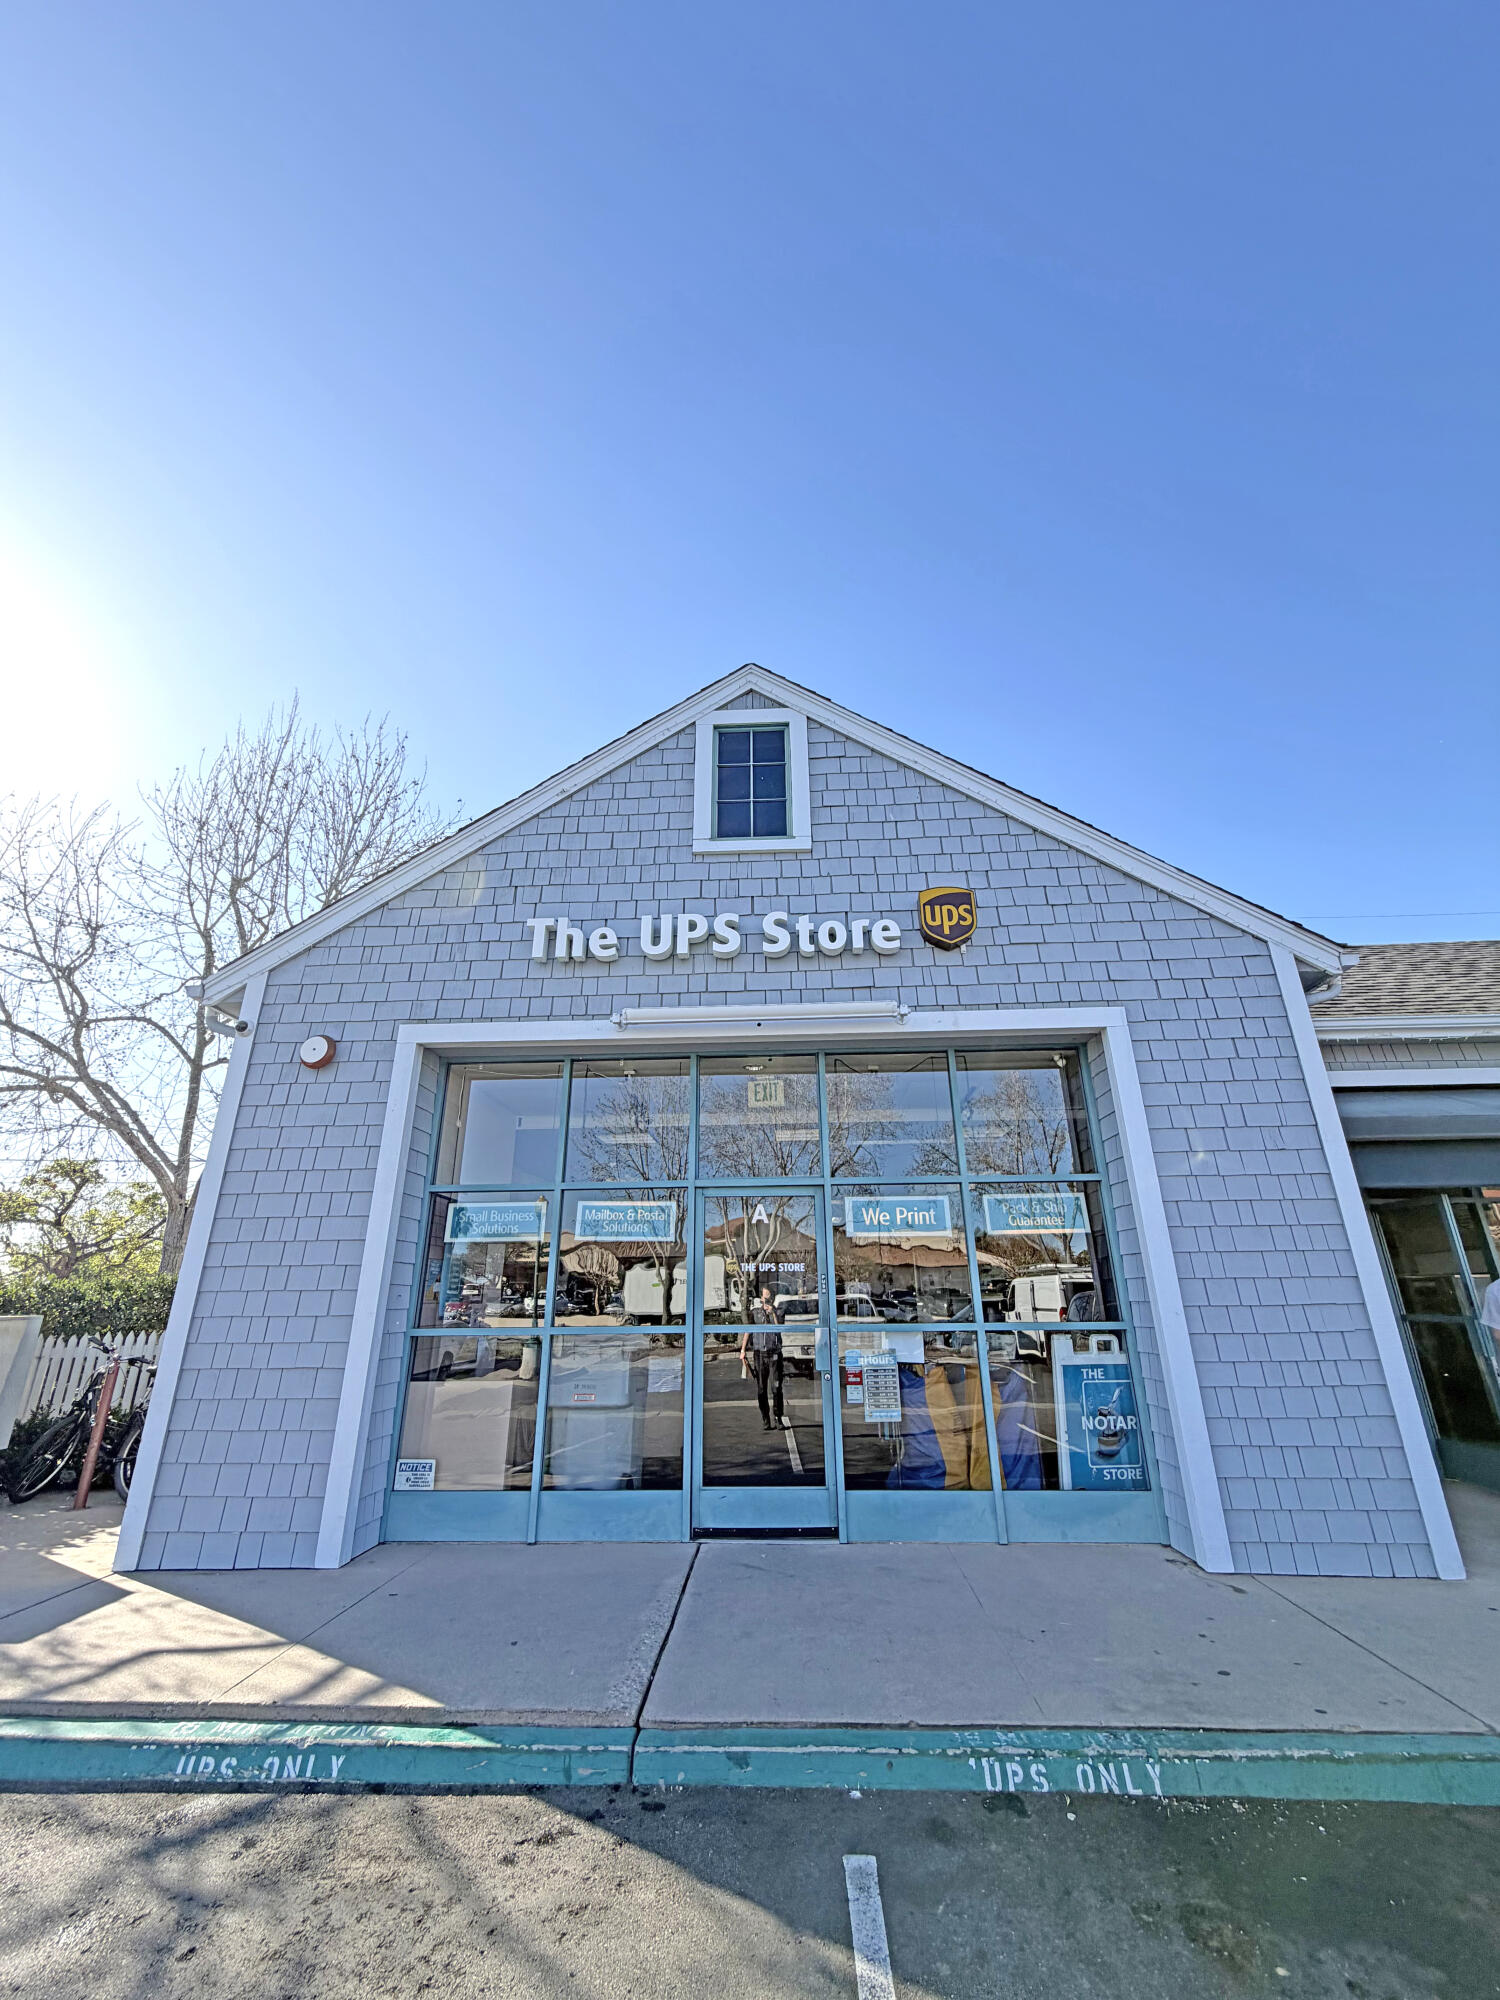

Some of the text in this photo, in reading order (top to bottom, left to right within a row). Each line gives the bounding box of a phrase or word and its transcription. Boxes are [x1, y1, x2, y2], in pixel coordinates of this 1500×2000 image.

[925, 904, 972, 935] ups
[526, 911, 902, 964] The UPS Store
[754, 1082, 779, 1102] EXIT
[751, 1203, 769, 1224] A
[1002, 1200, 1068, 1214] Pack & Ship
[459, 1209, 534, 1222] Small Business
[585, 1208, 668, 1221] Mailbox & Postal
[862, 1206, 937, 1225] We Print
[1008, 1214, 1065, 1226] Guarantee
[472, 1222, 519, 1234] Solutions
[602, 1221, 648, 1233] Solutions
[740, 1263, 806, 1271] THE UPS STORE
[864, 1355, 895, 1365] Hours
[1081, 1368, 1105, 1379] THE
[1082, 1415, 1137, 1430] NOTAR
[400, 1463, 432, 1472] NOTICE
[1103, 1469, 1144, 1480] STORE
[210, 1721, 262, 1736] MIN
[268, 1723, 389, 1737] PARKING
[175, 1753, 346, 1779] UPS ONLY
[983, 1759, 1163, 1796] UPS ONLY
